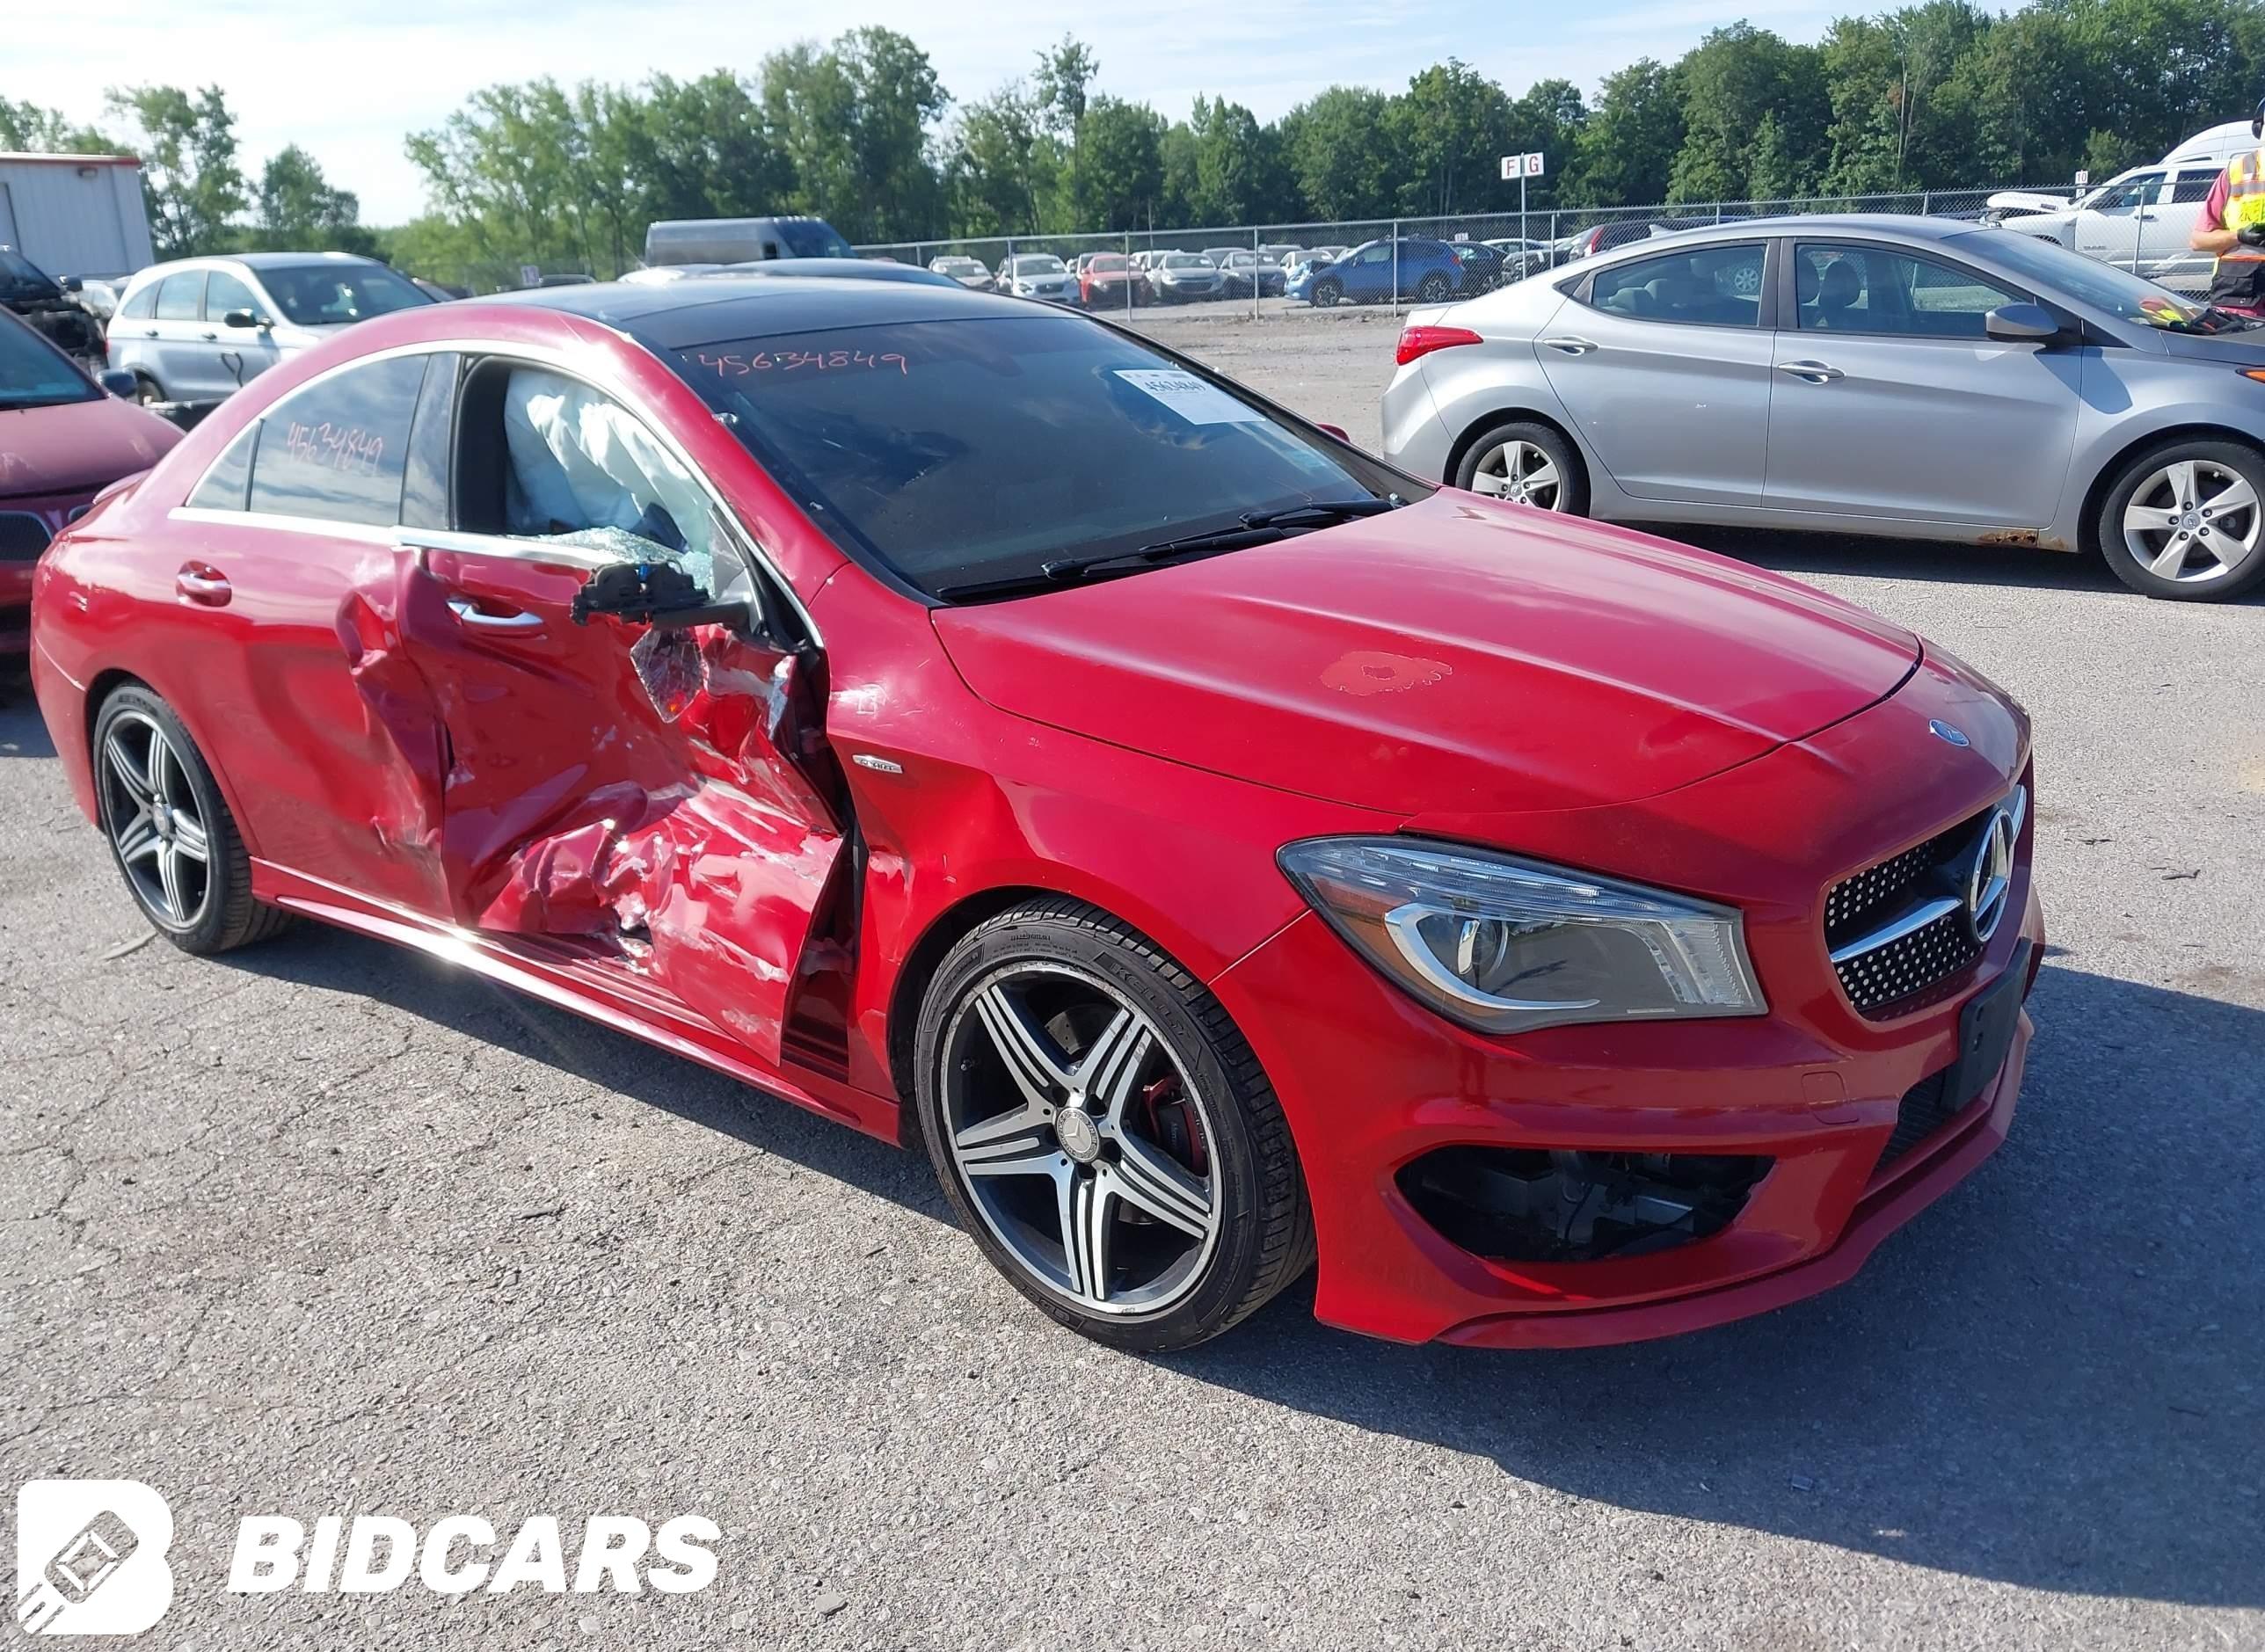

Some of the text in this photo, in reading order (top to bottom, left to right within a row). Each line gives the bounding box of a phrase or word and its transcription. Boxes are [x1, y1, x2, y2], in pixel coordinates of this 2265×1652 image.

[1506, 158, 1516, 177] F
[1529, 156, 1539, 173] G
[2077, 172, 2087, 182] 10
[698, 351, 908, 376] 45634849
[288, 421, 383, 475] 45634849
